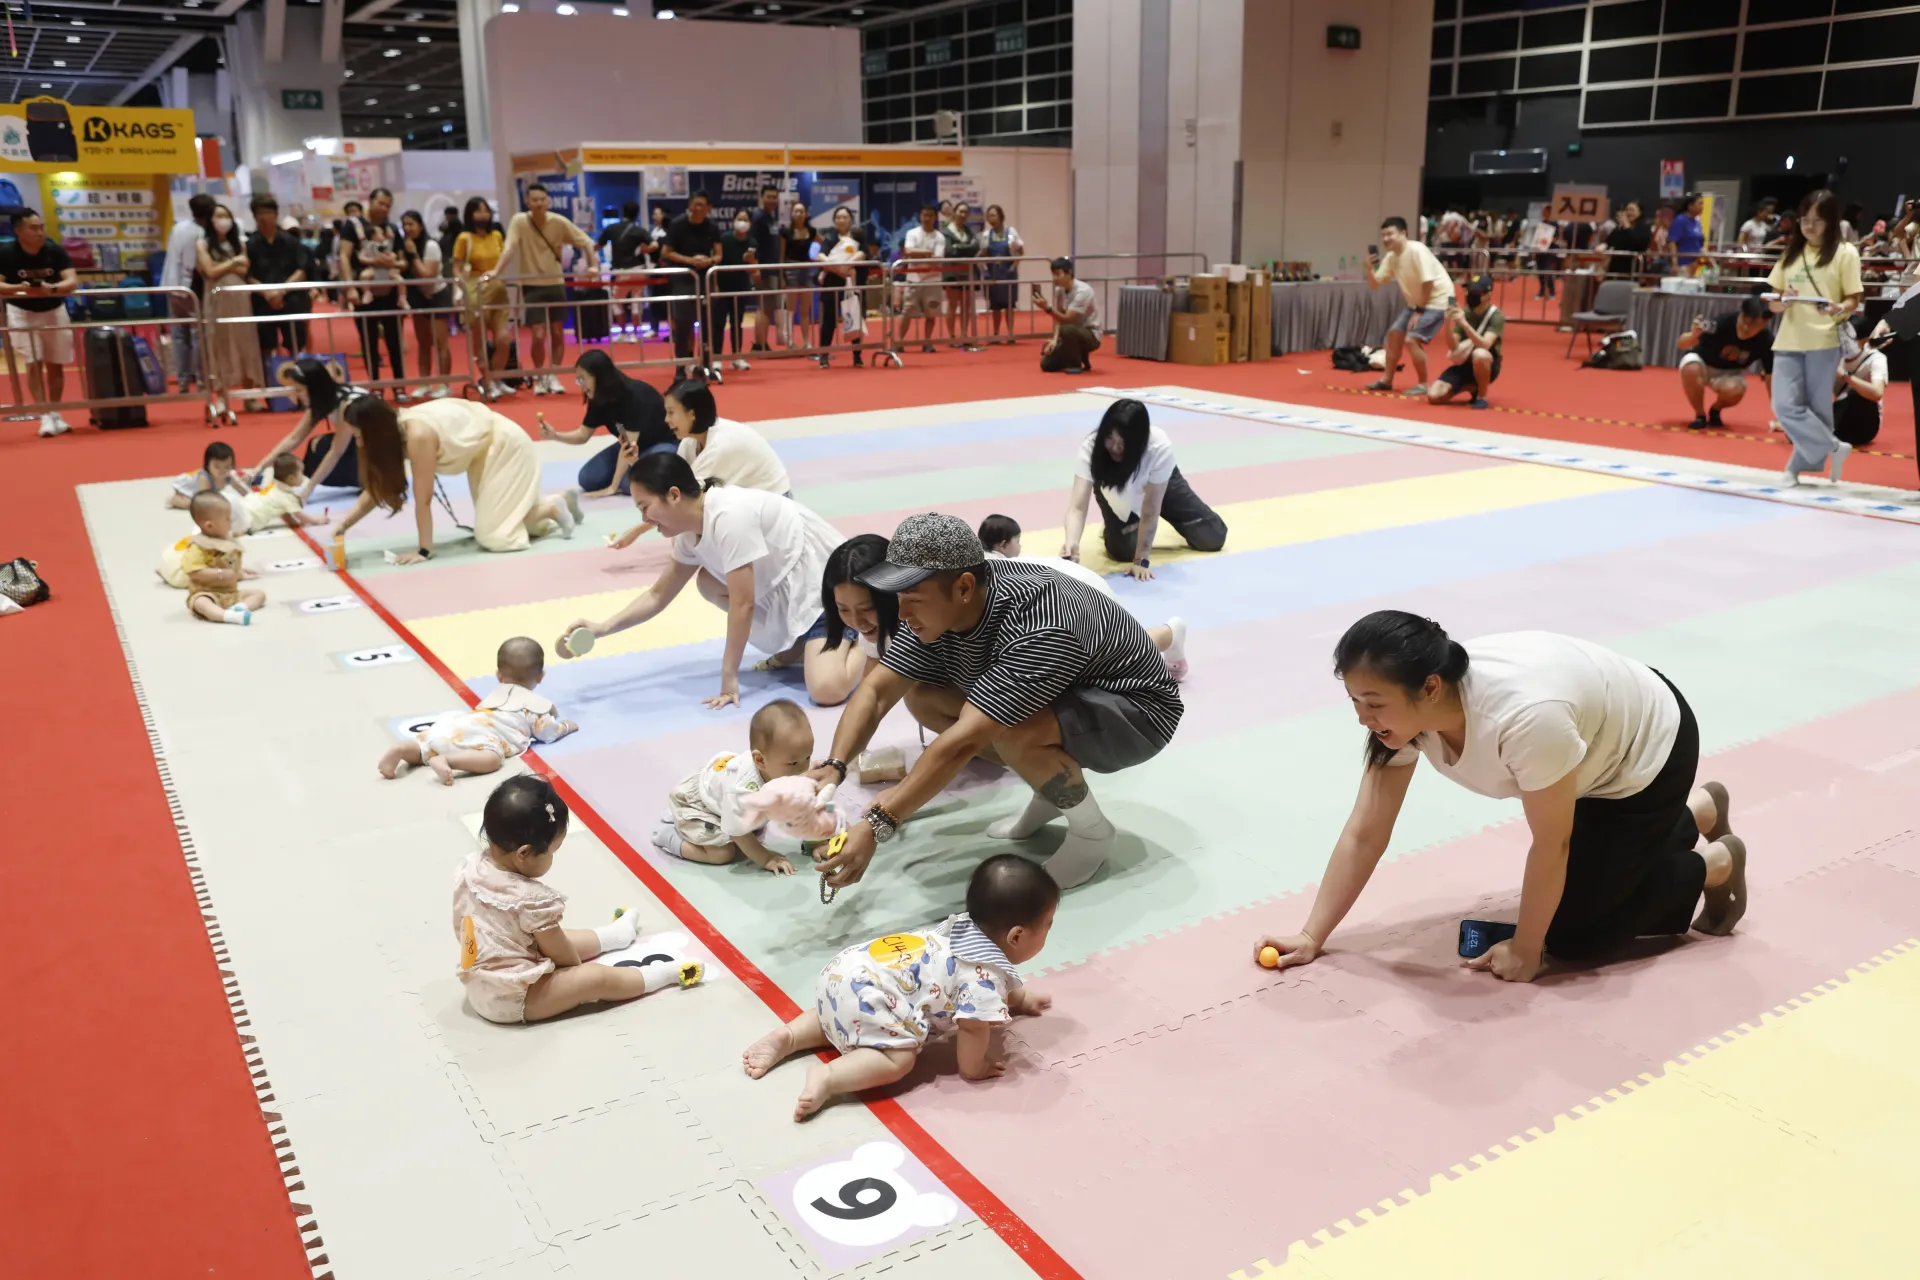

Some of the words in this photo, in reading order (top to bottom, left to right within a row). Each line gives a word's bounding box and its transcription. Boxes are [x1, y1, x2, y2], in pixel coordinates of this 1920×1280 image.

[114, 123, 176, 139] KAGS
[1558, 197, 1598, 216] 入口
[353, 652, 392, 661] 5
[1470, 929, 1479, 949] 12:17
[810, 1177, 897, 1220] 9
